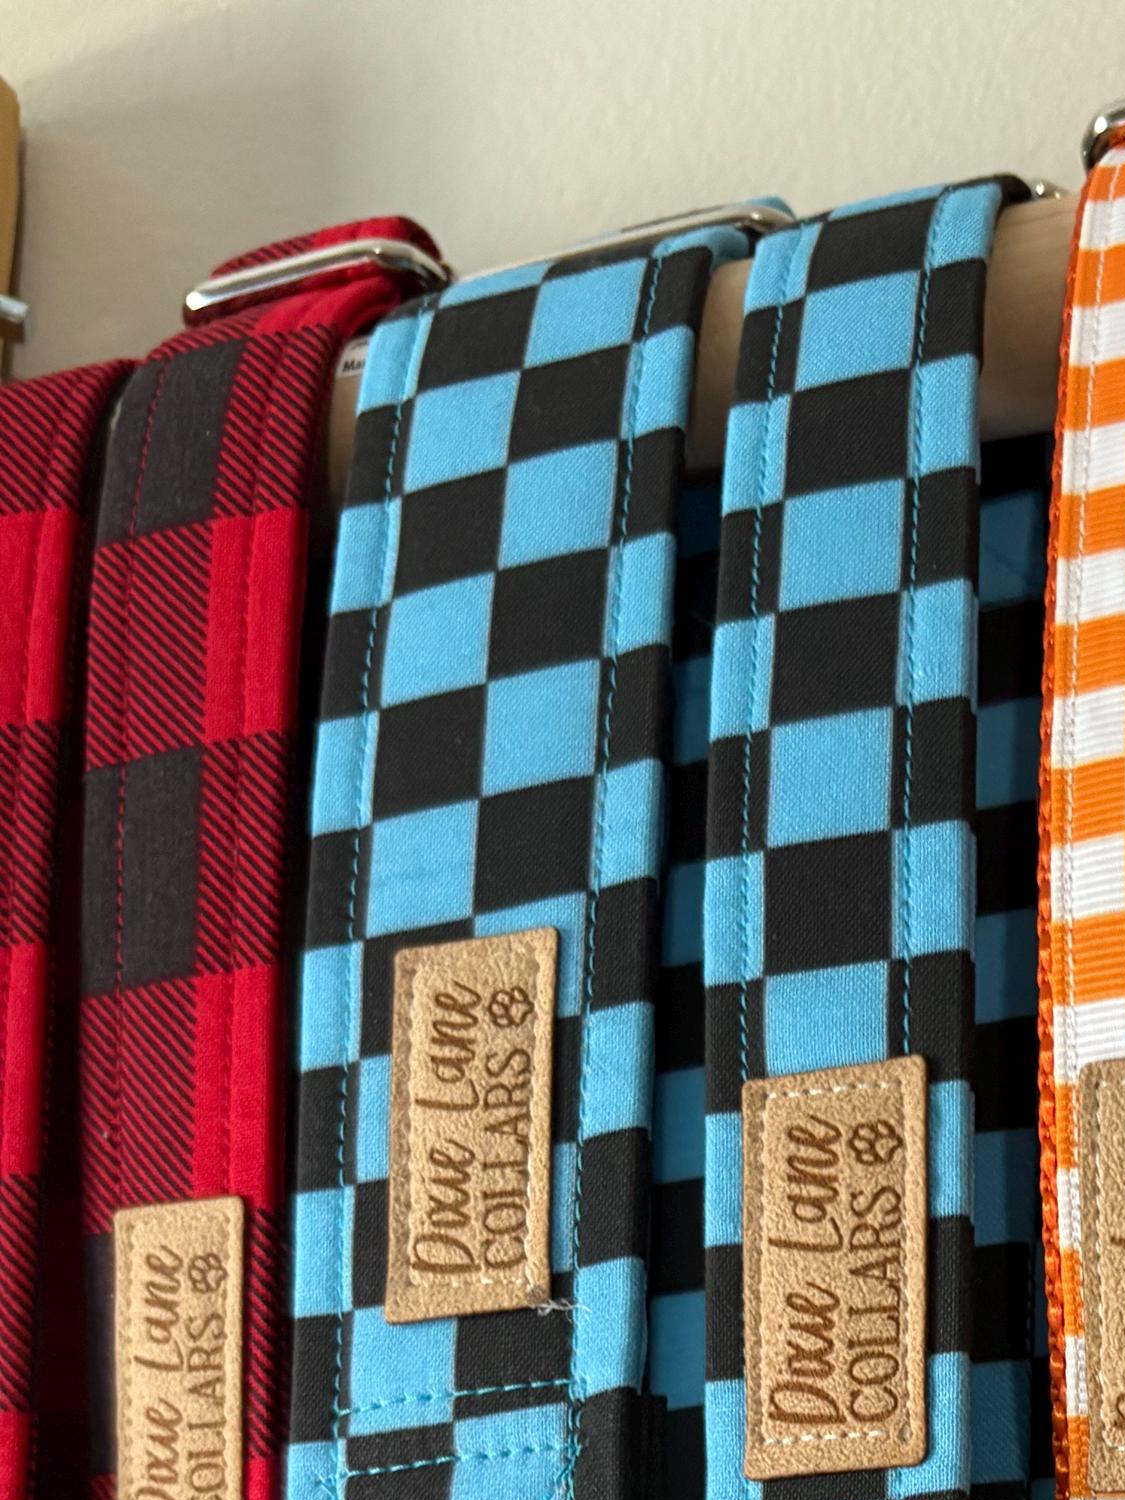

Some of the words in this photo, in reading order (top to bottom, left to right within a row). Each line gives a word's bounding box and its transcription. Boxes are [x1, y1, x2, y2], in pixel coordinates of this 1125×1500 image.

[415, 980, 481, 1112] Lane
[411, 1138, 480, 1275] Dixie
[482, 1048, 533, 1270] COLLARS
[768, 1114, 843, 1254] Lane
[133, 1245, 184, 1372] Lane
[769, 1282, 846, 1425] Dixie
[849, 1186, 901, 1423] COLLARS
